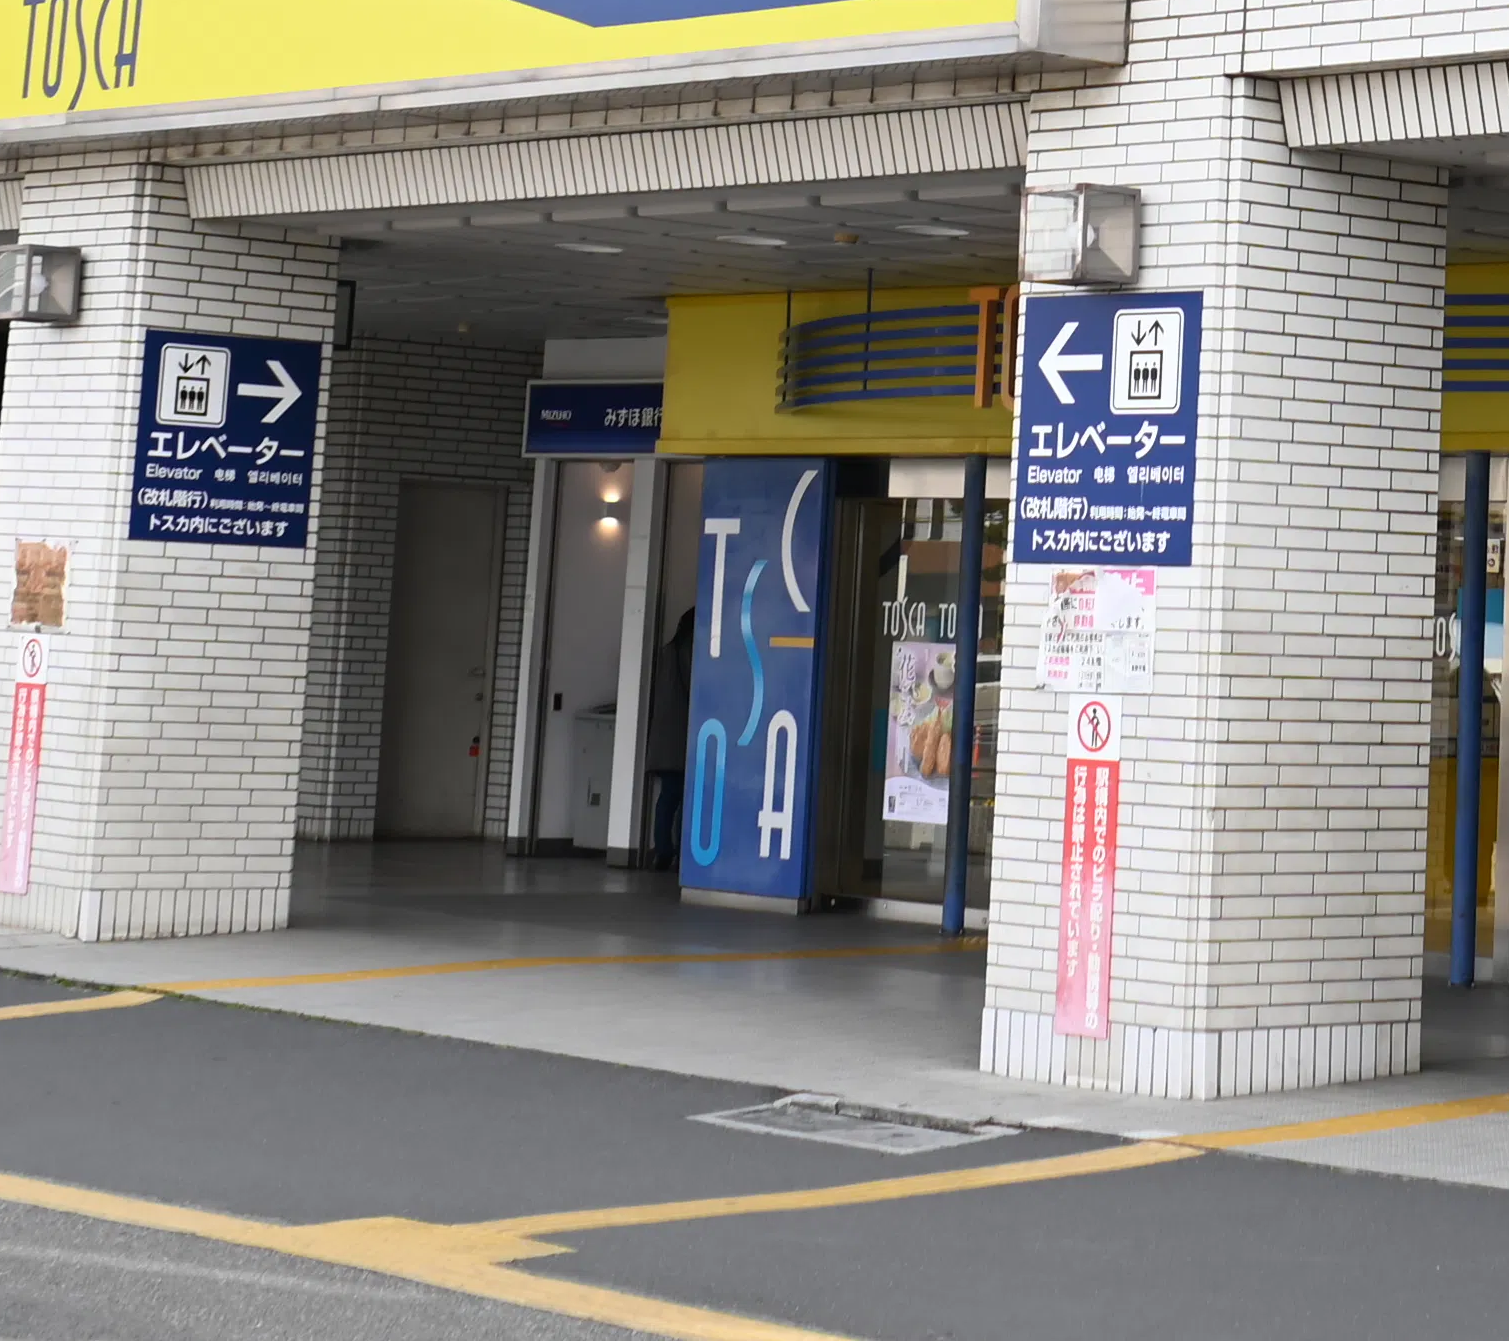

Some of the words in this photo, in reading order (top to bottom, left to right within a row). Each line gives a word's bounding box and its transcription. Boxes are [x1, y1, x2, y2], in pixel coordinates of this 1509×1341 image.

[147, 431, 305, 465] エレベーター
[1028, 420, 1186, 460] エレベーター
[145, 463, 203, 480] Elevator
[1027, 465, 1083, 484] Elevator
[149, 513, 289, 537] トスカ内にございます
[1031, 528, 1171, 553] トスカ内にございます
[882, 596, 926, 640] TOSCA
